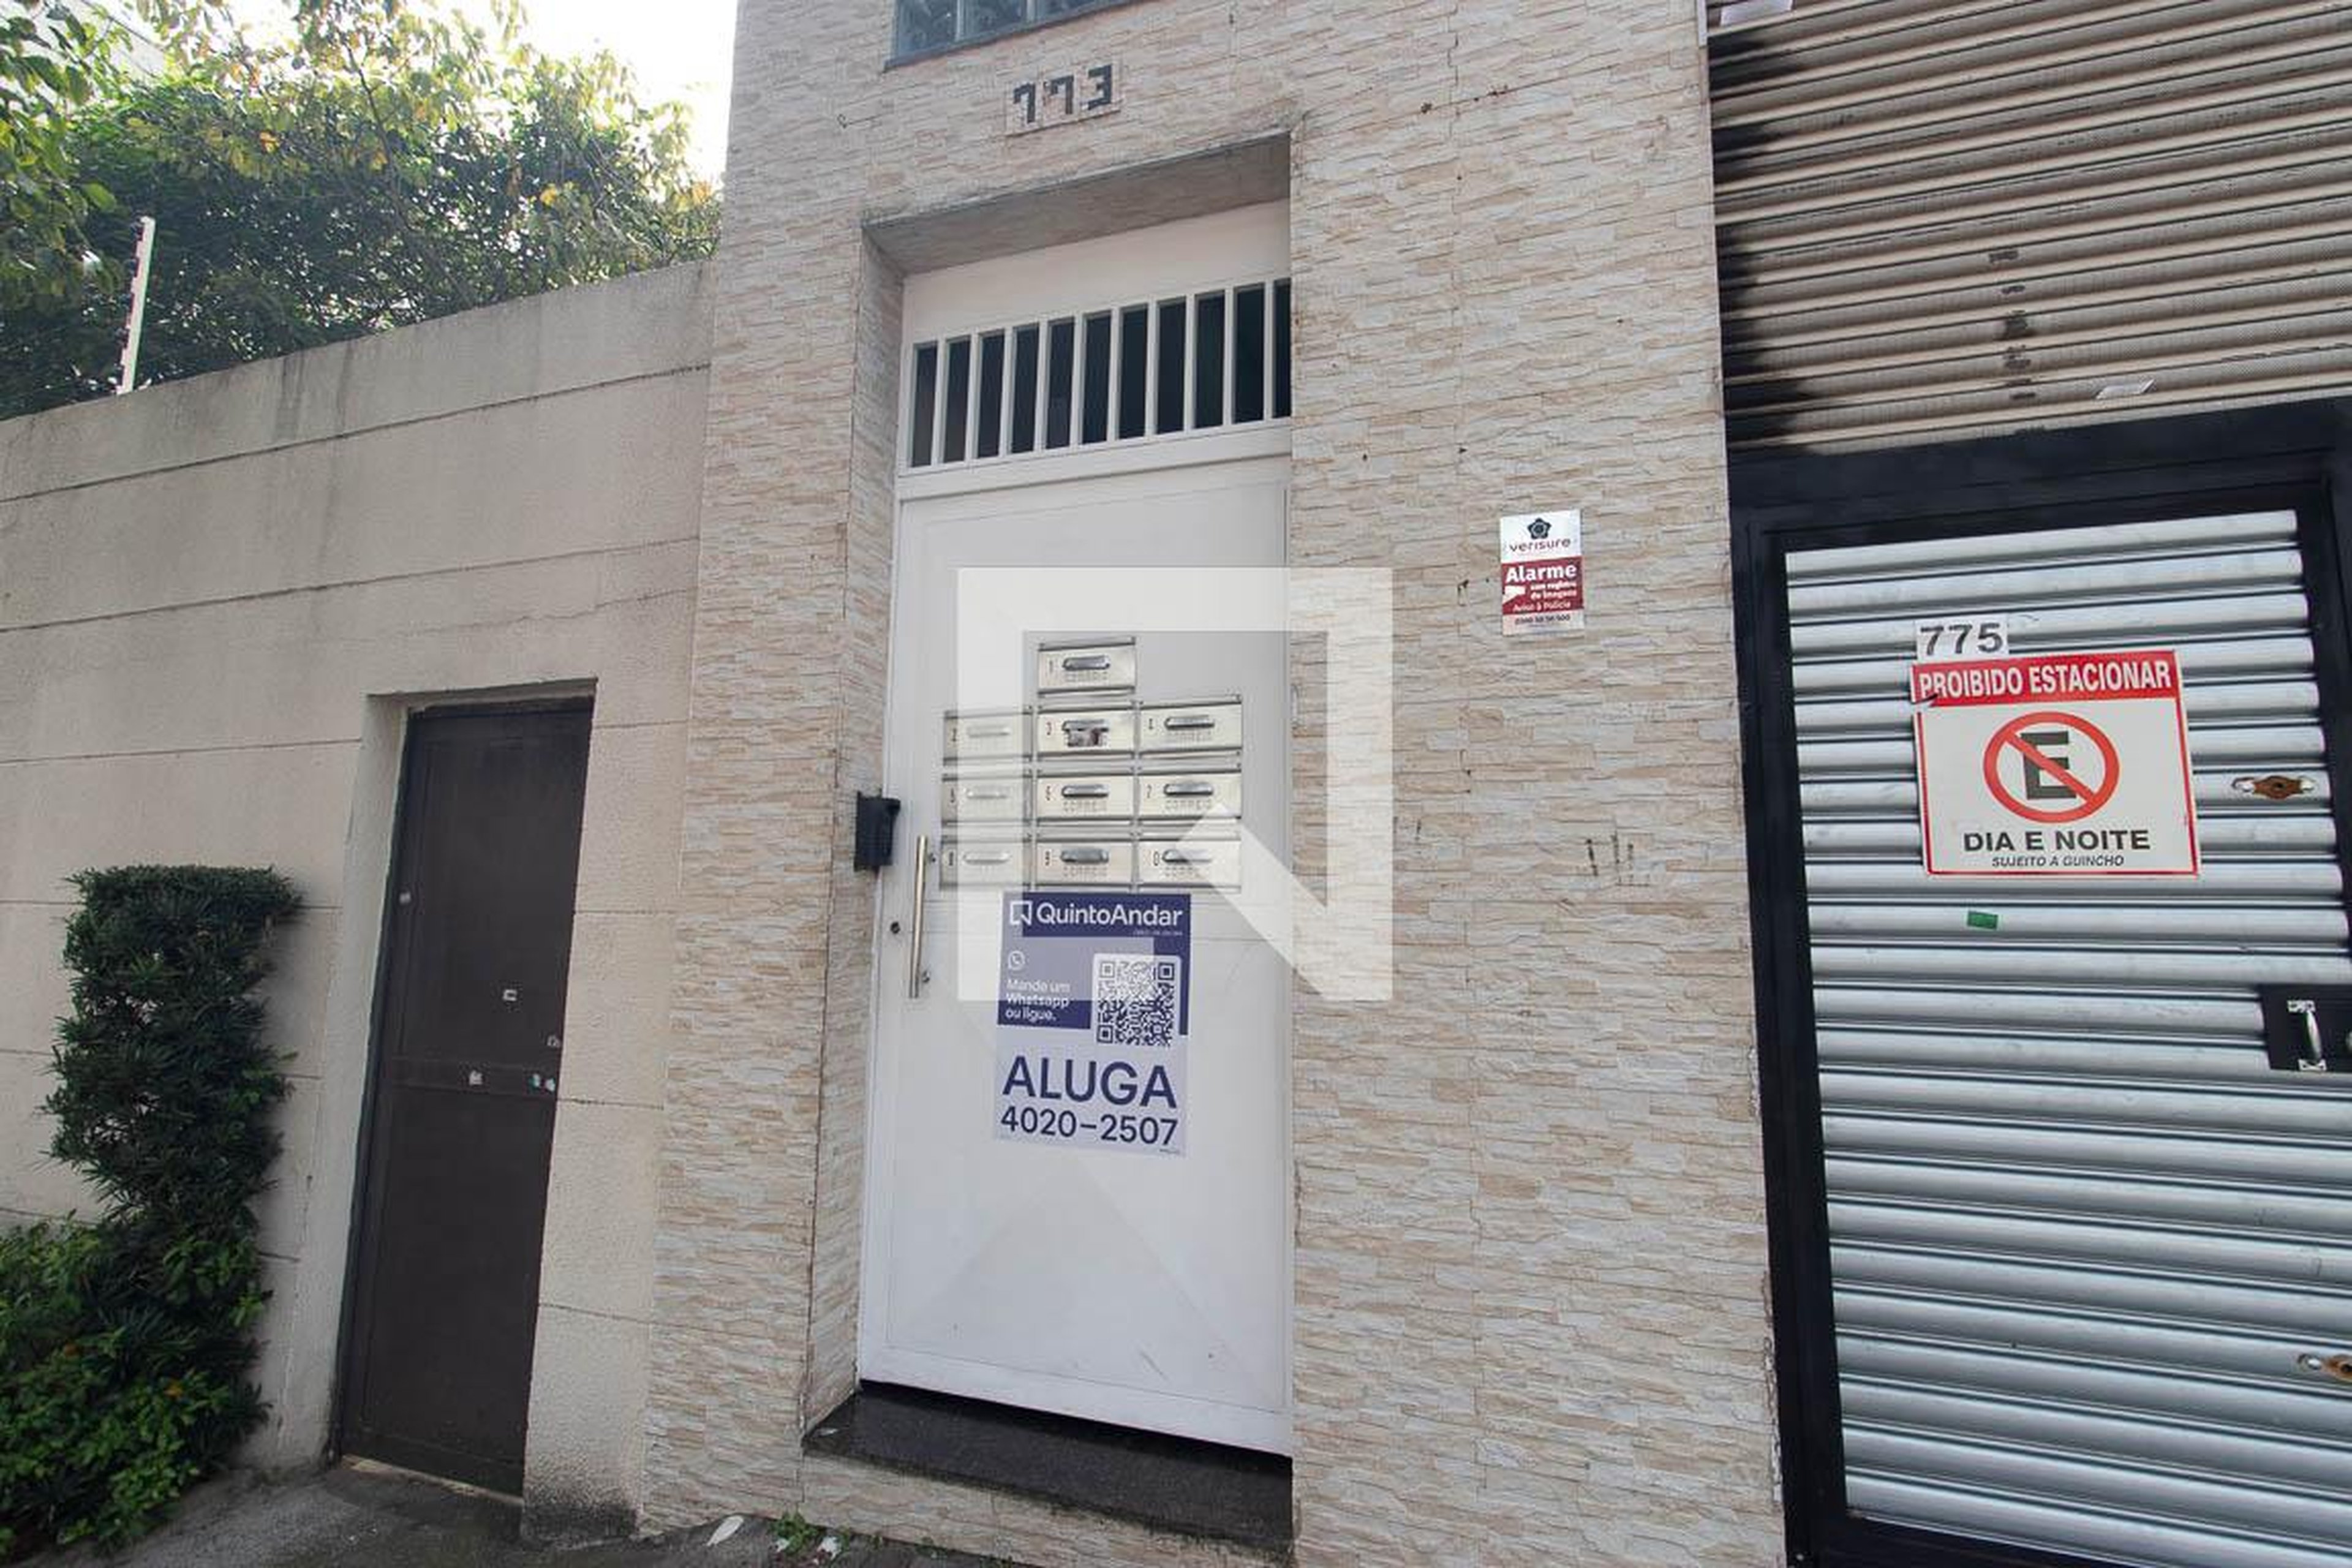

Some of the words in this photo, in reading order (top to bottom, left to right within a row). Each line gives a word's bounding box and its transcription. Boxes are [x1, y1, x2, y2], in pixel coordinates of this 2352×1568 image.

[1013, 64, 1112, 124] 773
[1509, 538, 1571, 552] verisure
[1506, 564, 1577, 583] Alarme
[1921, 623, 2003, 656] 775
[1919, 666, 2022, 698] PROIBIDO
[2029, 660, 2171, 693] ESTACIONAR
[2021, 731, 2077, 800] E
[1964, 832, 2015, 852] DIA
[2026, 832, 2043, 850] E
[2056, 829, 2151, 850] NOITE
[1992, 856, 2046, 867] SUJEITO
[2049, 856, 2059, 866] A
[2063, 855, 2124, 866] GUINCHO
[1036, 902, 1183, 926] QuintoAndar
[1006, 993, 1069, 1009] Whatsapp
[1002, 1055, 1177, 1109] ALUGA
[1000, 1106, 1178, 1146] 4020-2507
